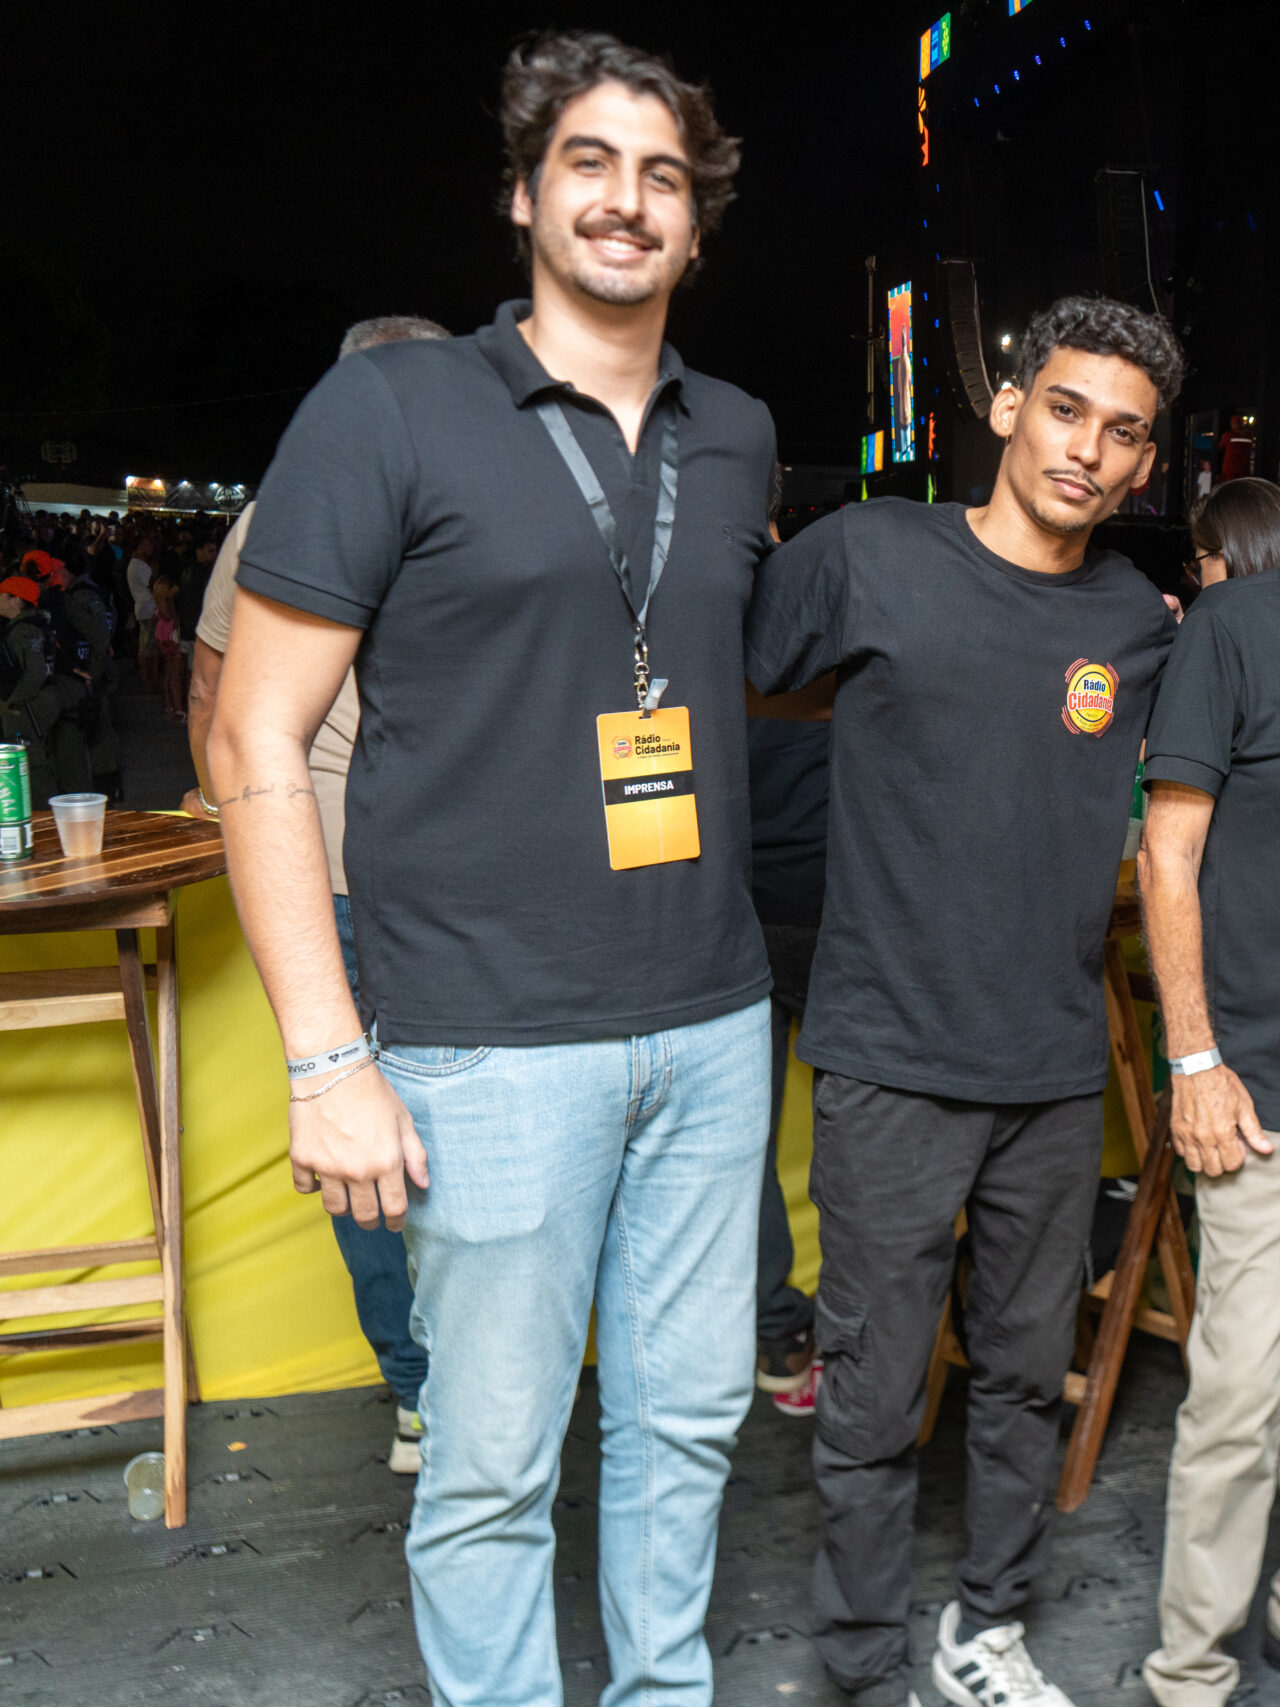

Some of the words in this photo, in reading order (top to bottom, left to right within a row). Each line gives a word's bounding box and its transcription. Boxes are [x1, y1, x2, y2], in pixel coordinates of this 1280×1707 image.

[1083, 679, 1106, 692] Rádio
[634, 734, 661, 745] Rádio
[635, 742, 680, 755] Cidadania
[624, 779, 675, 795] IMPRENSA
